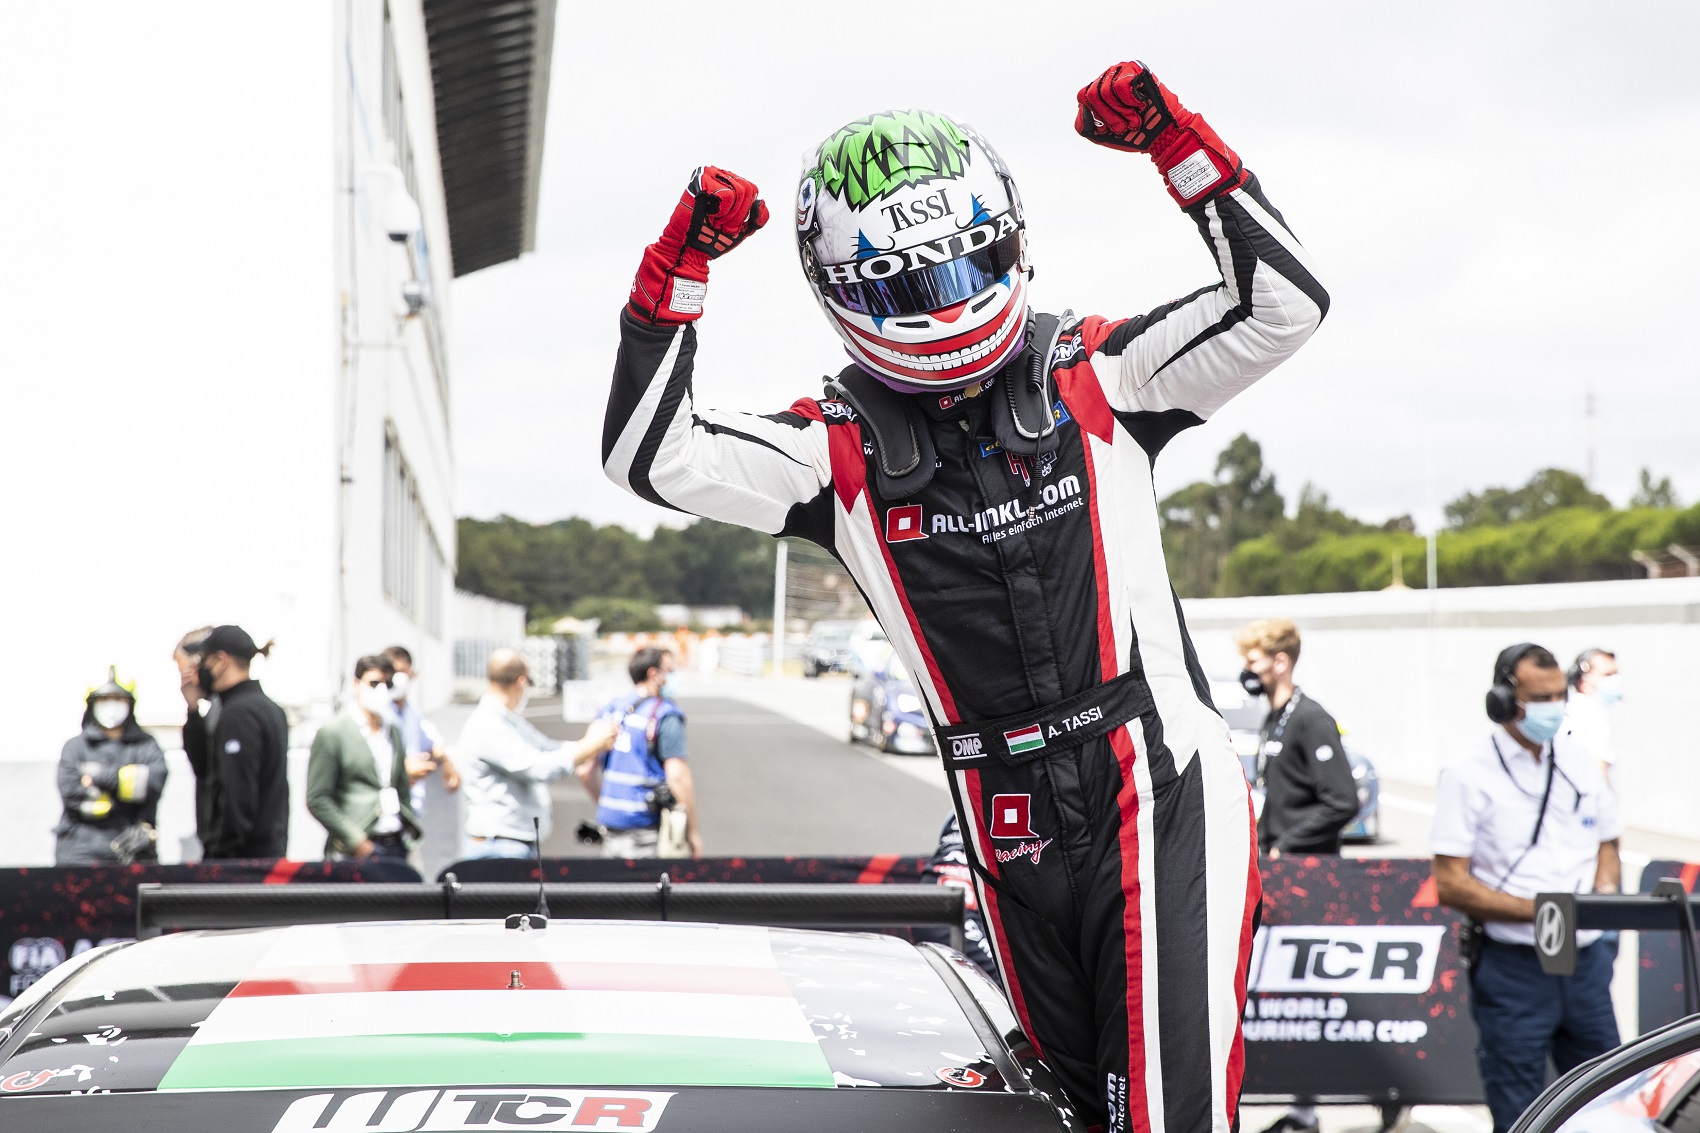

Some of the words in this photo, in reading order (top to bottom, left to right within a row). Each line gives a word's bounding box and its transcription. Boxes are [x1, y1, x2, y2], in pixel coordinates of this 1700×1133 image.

[880, 188, 955, 233] TASSI
[823, 212, 1018, 284] HONDA
[982, 530, 1006, 544] Alles
[1008, 513, 1043, 536] einfach
[1045, 497, 1084, 521] Internet
[1048, 725, 1062, 739] A.
[1062, 706, 1103, 732] TASSI
[952, 737, 983, 757] OMP
[1281, 939, 1423, 981] TCR
[1258, 997, 1348, 1020] WORLD
[1243, 1020, 1321, 1041] URING
[1324, 1020, 1374, 1042] CAR
[1376, 1020, 1428, 1043] CUP
[1117, 1076, 1125, 1131] Internet
